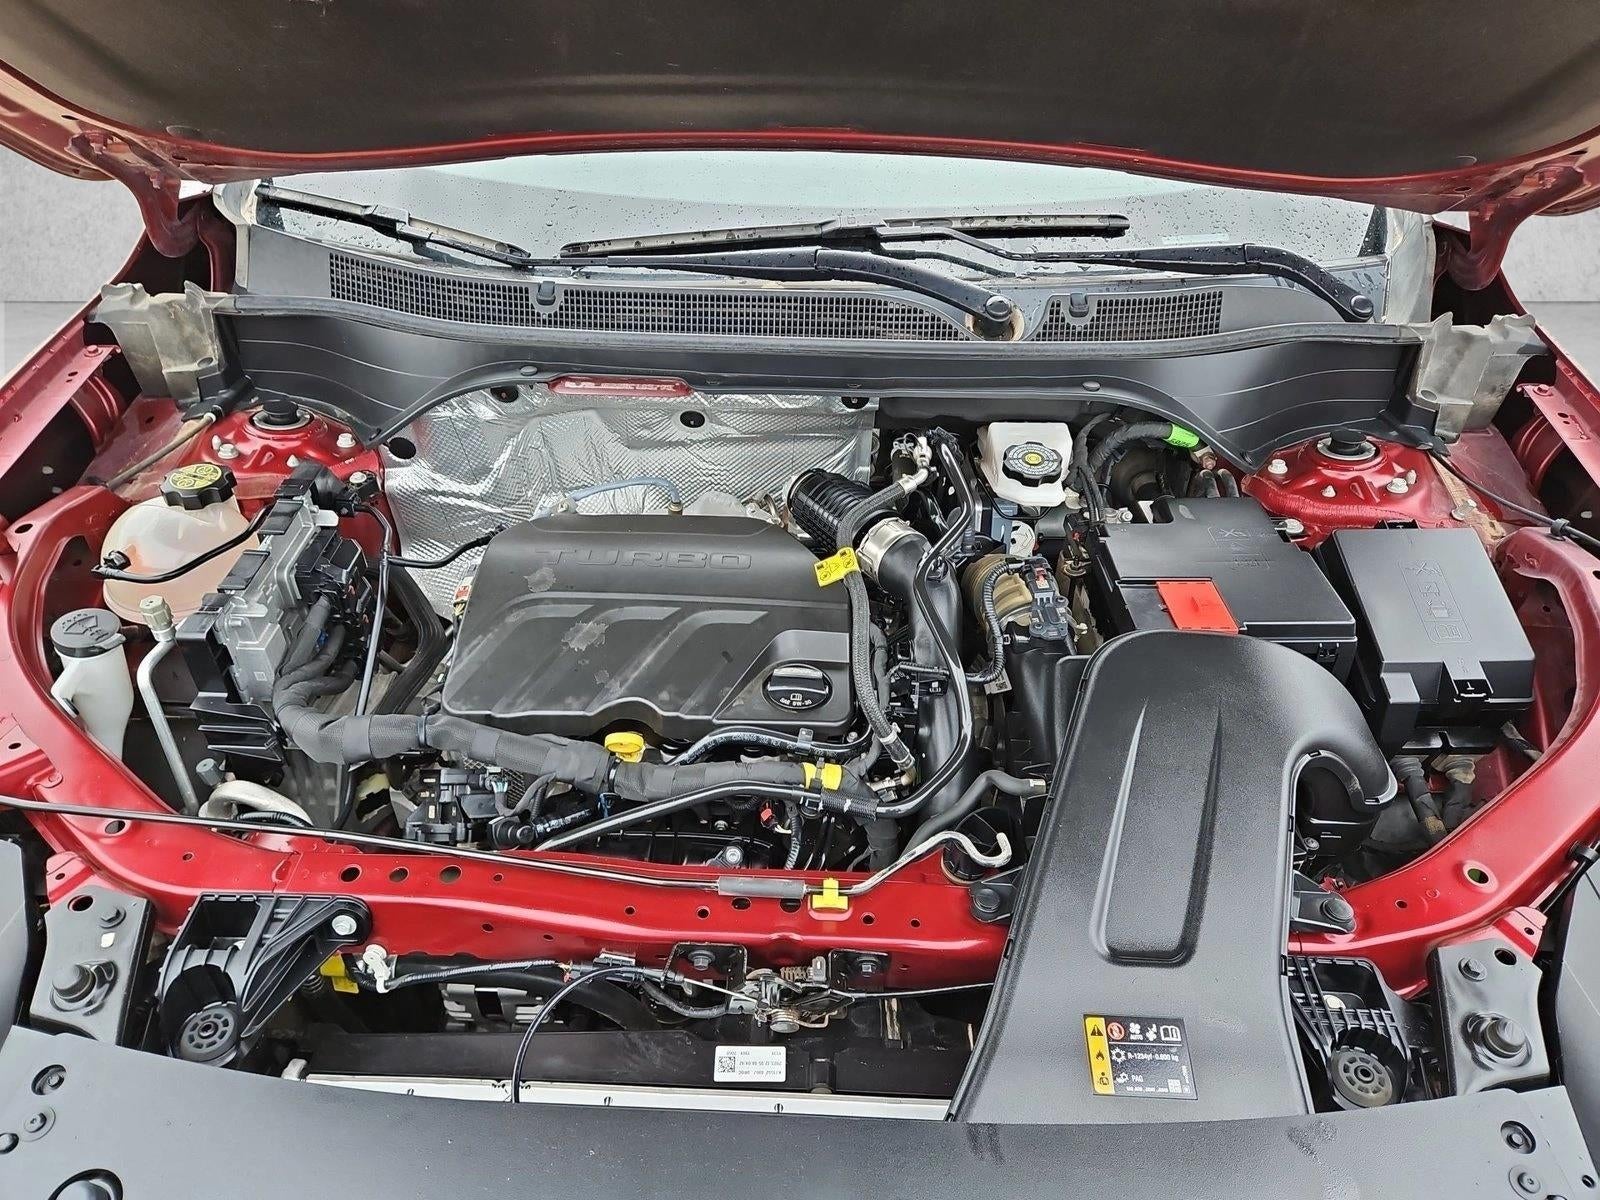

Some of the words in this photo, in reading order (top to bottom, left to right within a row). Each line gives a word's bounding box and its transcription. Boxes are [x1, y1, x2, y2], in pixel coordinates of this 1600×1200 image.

[535, 549, 752, 570] TURBO
[779, 697, 791, 705] SAE
[1171, 1053, 1180, 1063] kg
[1131, 1074, 1144, 1083] PAG
